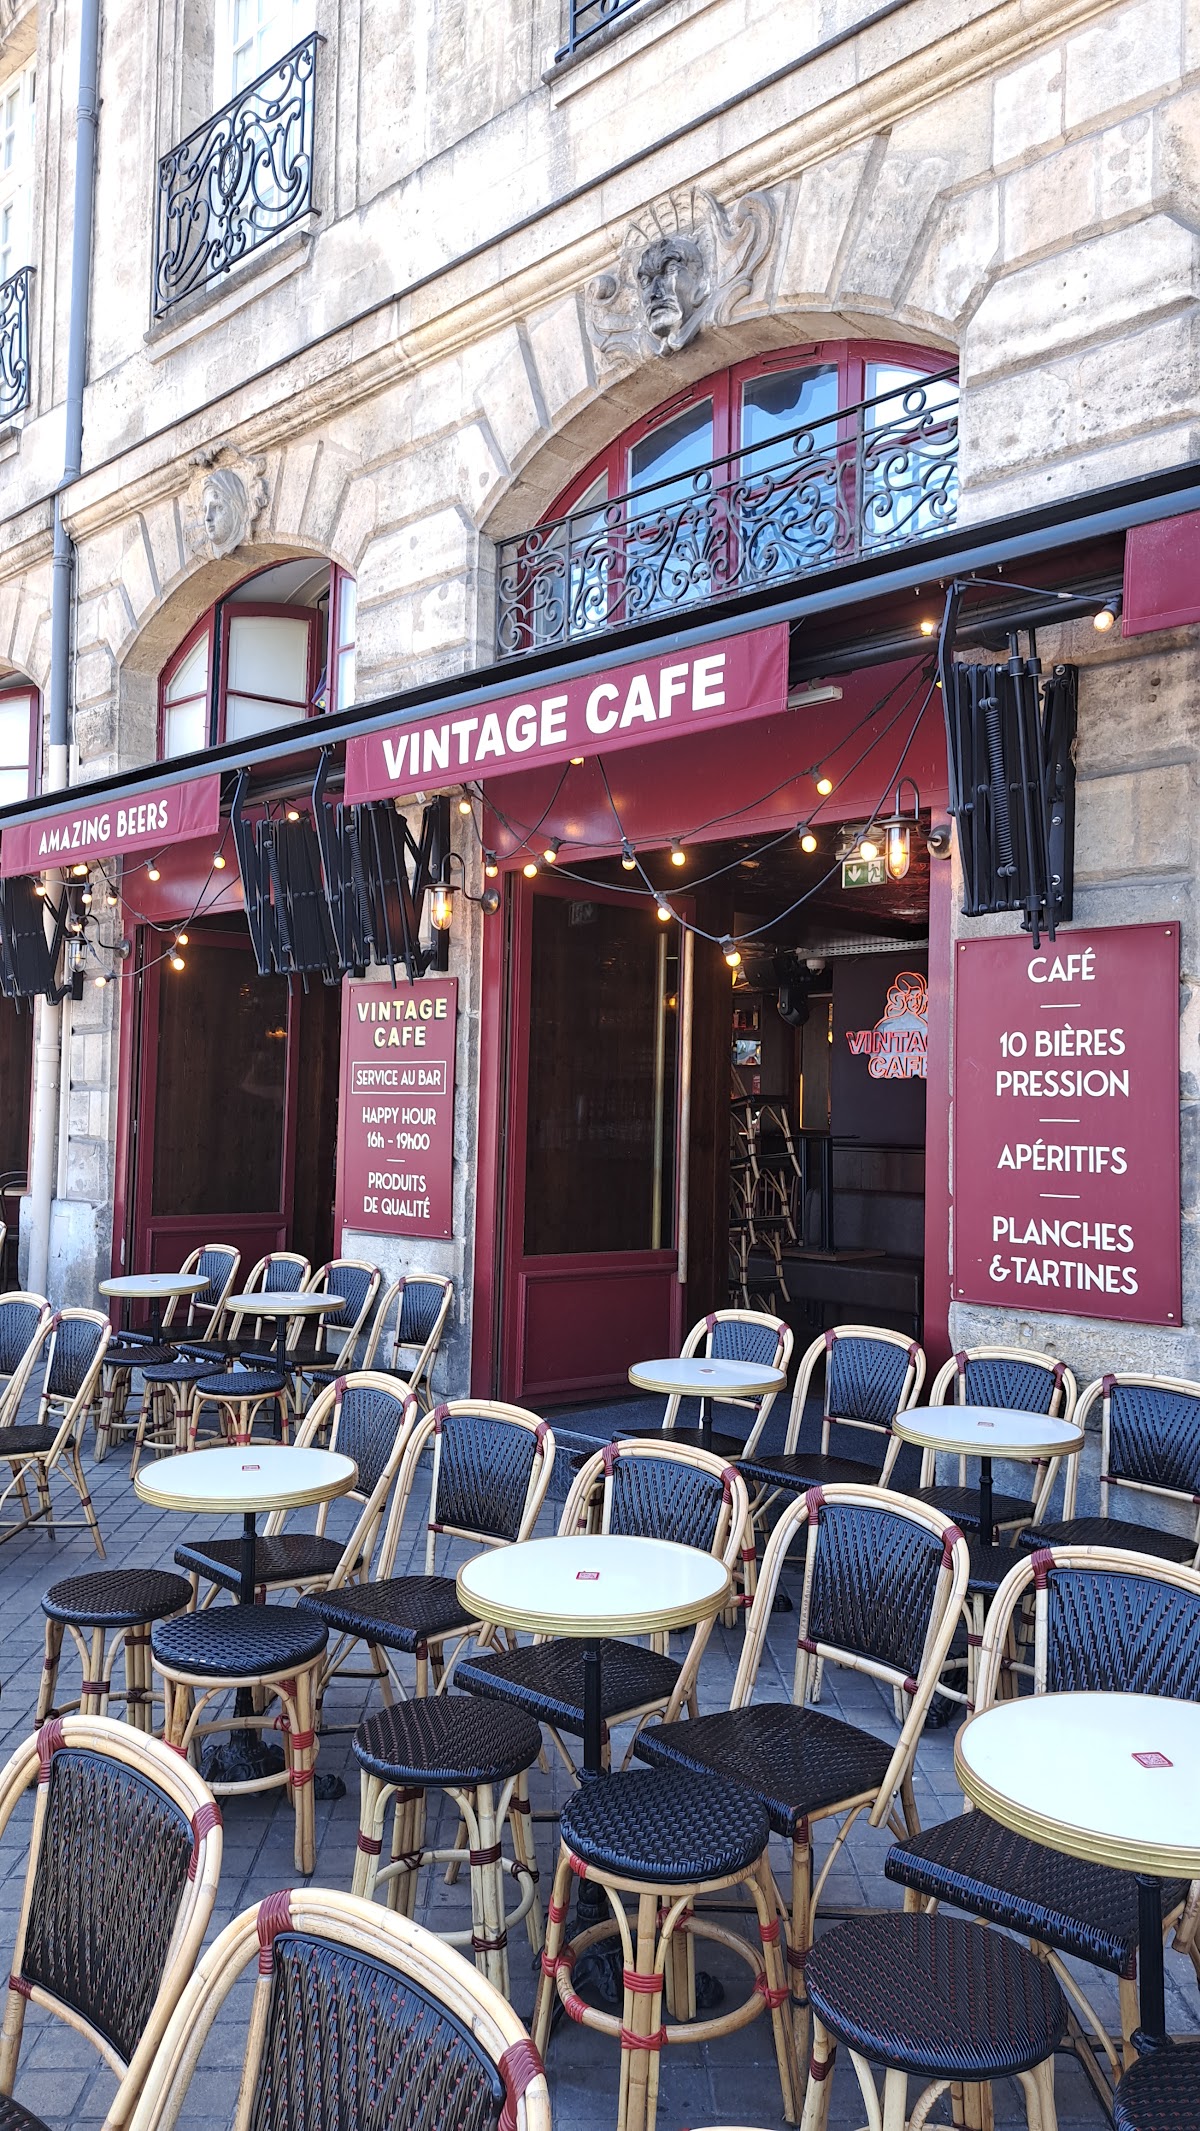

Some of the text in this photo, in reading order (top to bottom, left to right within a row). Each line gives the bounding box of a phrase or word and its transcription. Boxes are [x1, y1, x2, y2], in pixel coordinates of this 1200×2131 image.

[381, 652, 726, 780] VINTAGE CAFE
[38, 799, 169, 856] AMAZING BEERS
[1027, 946, 1097, 984] CAFÉ
[357, 997, 448, 1022] VINTAGE
[373, 1026, 427, 1048] CAFE
[845, 1030, 928, 1055] VINTA
[999, 1022, 1126, 1058] 10 BIÈRES
[355, 1069, 442, 1086] SERVICE AU BAR
[996, 1070, 1130, 1098] PRESSION
[362, 1106, 437, 1126] HAPPY HOUR
[366, 1131, 385, 1149] 16h
[396, 1132, 431, 1151] 19h00
[996, 1138, 1128, 1175] APÉRITIFS
[367, 1171, 427, 1193] PRODUITS
[363, 1195, 431, 1219] DE QUALITÉ
[992, 1215, 1135, 1253] PLANCHES
